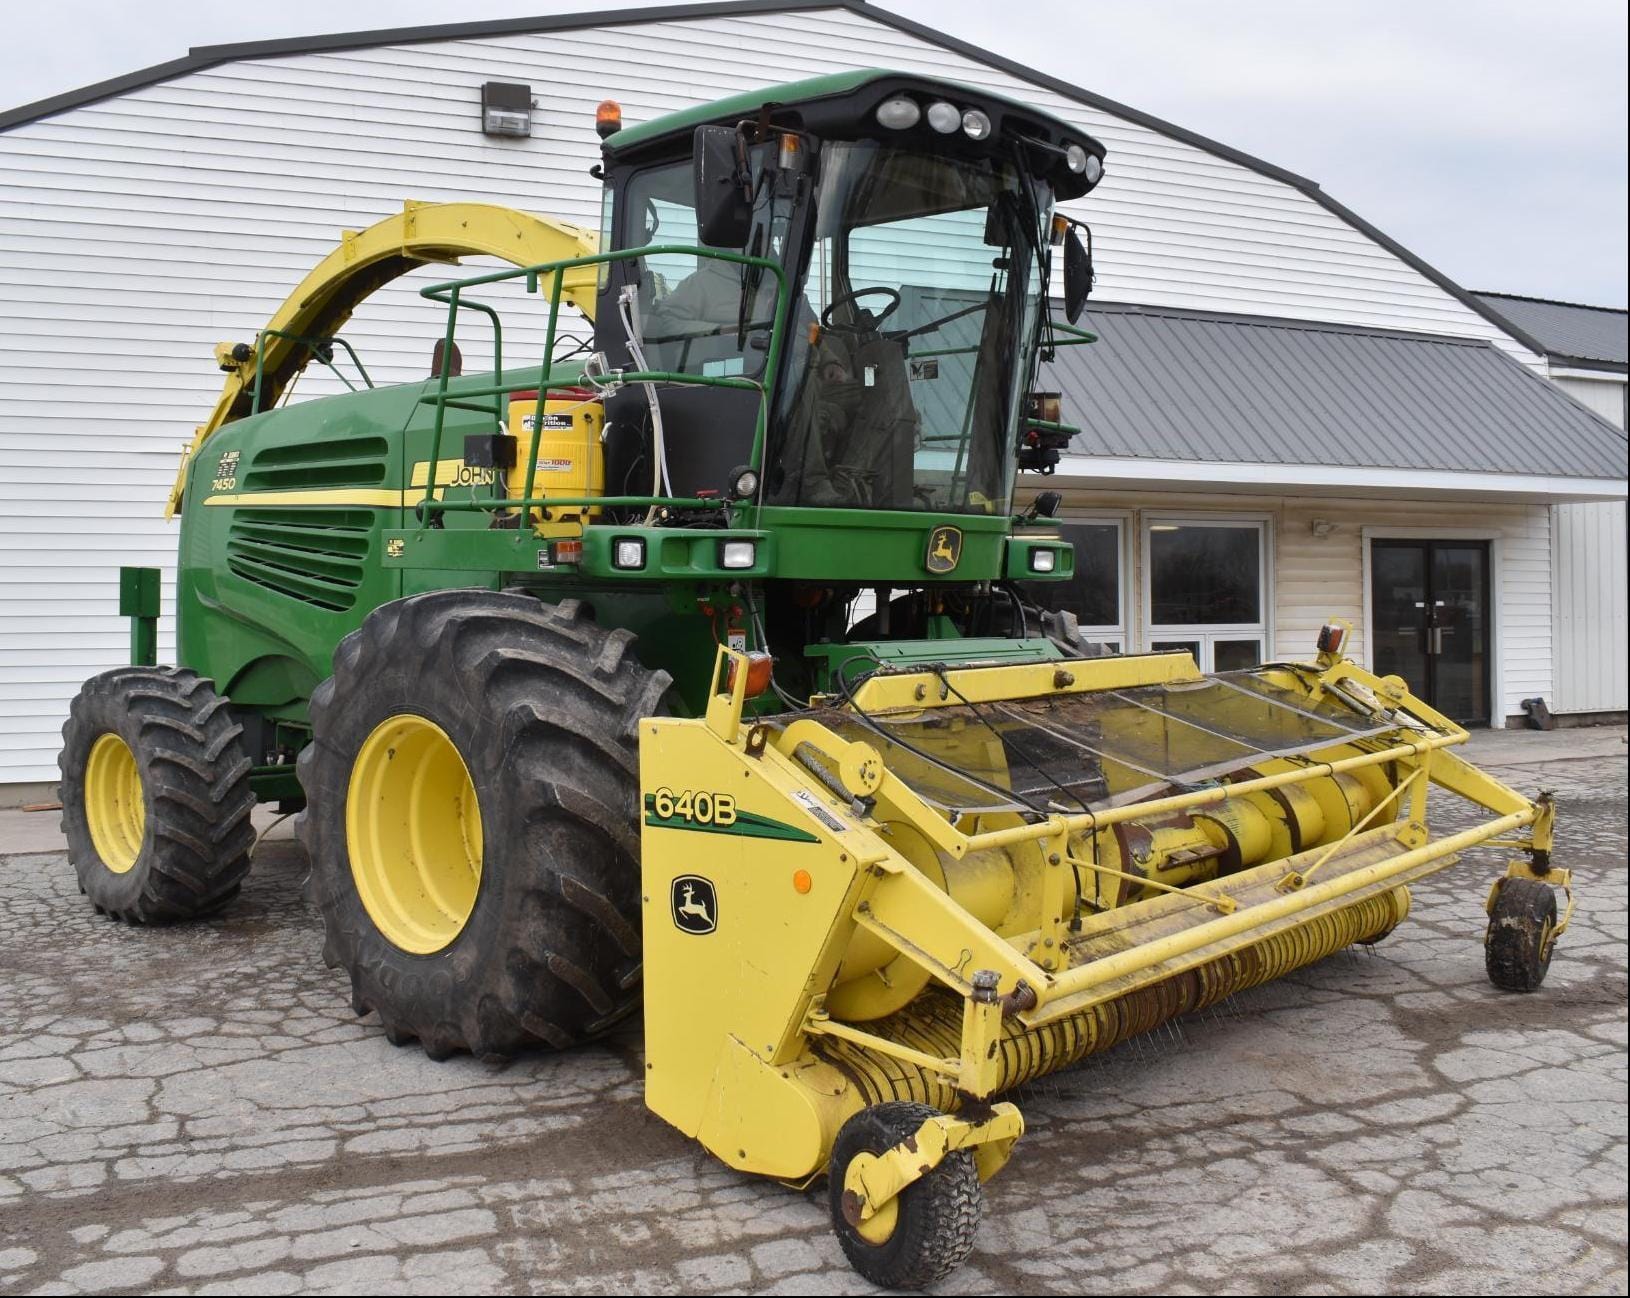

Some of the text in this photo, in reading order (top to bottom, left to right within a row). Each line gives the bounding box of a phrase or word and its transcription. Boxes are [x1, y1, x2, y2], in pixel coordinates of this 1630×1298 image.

[451, 465, 494, 484] JOHN
[211, 478, 236, 491] 7450
[655, 787, 737, 827] 640B
